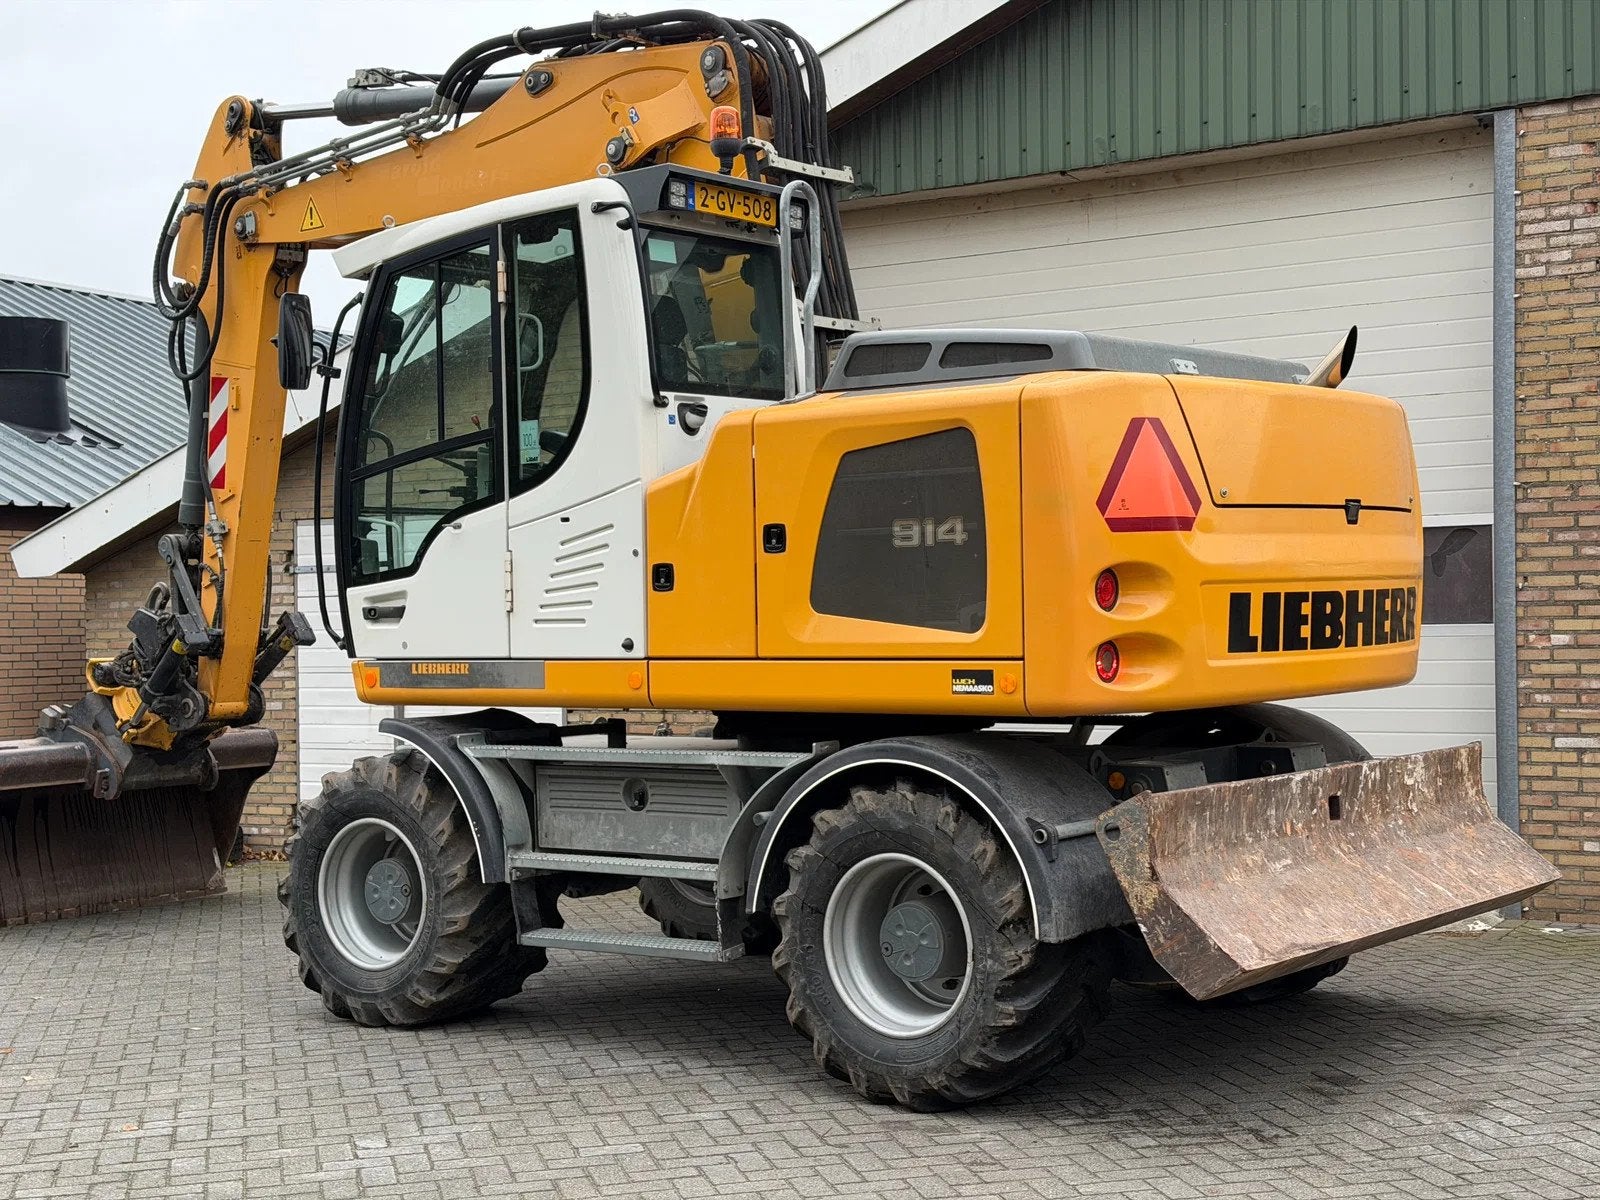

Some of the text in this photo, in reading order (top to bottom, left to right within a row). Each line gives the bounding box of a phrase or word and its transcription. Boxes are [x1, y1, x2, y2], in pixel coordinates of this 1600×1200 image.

[700, 186, 771, 221] 2-GV-508
[892, 515, 969, 548] 914
[1228, 587, 1416, 653] LIEBHERR
[411, 663, 470, 674] LIEBHERR
